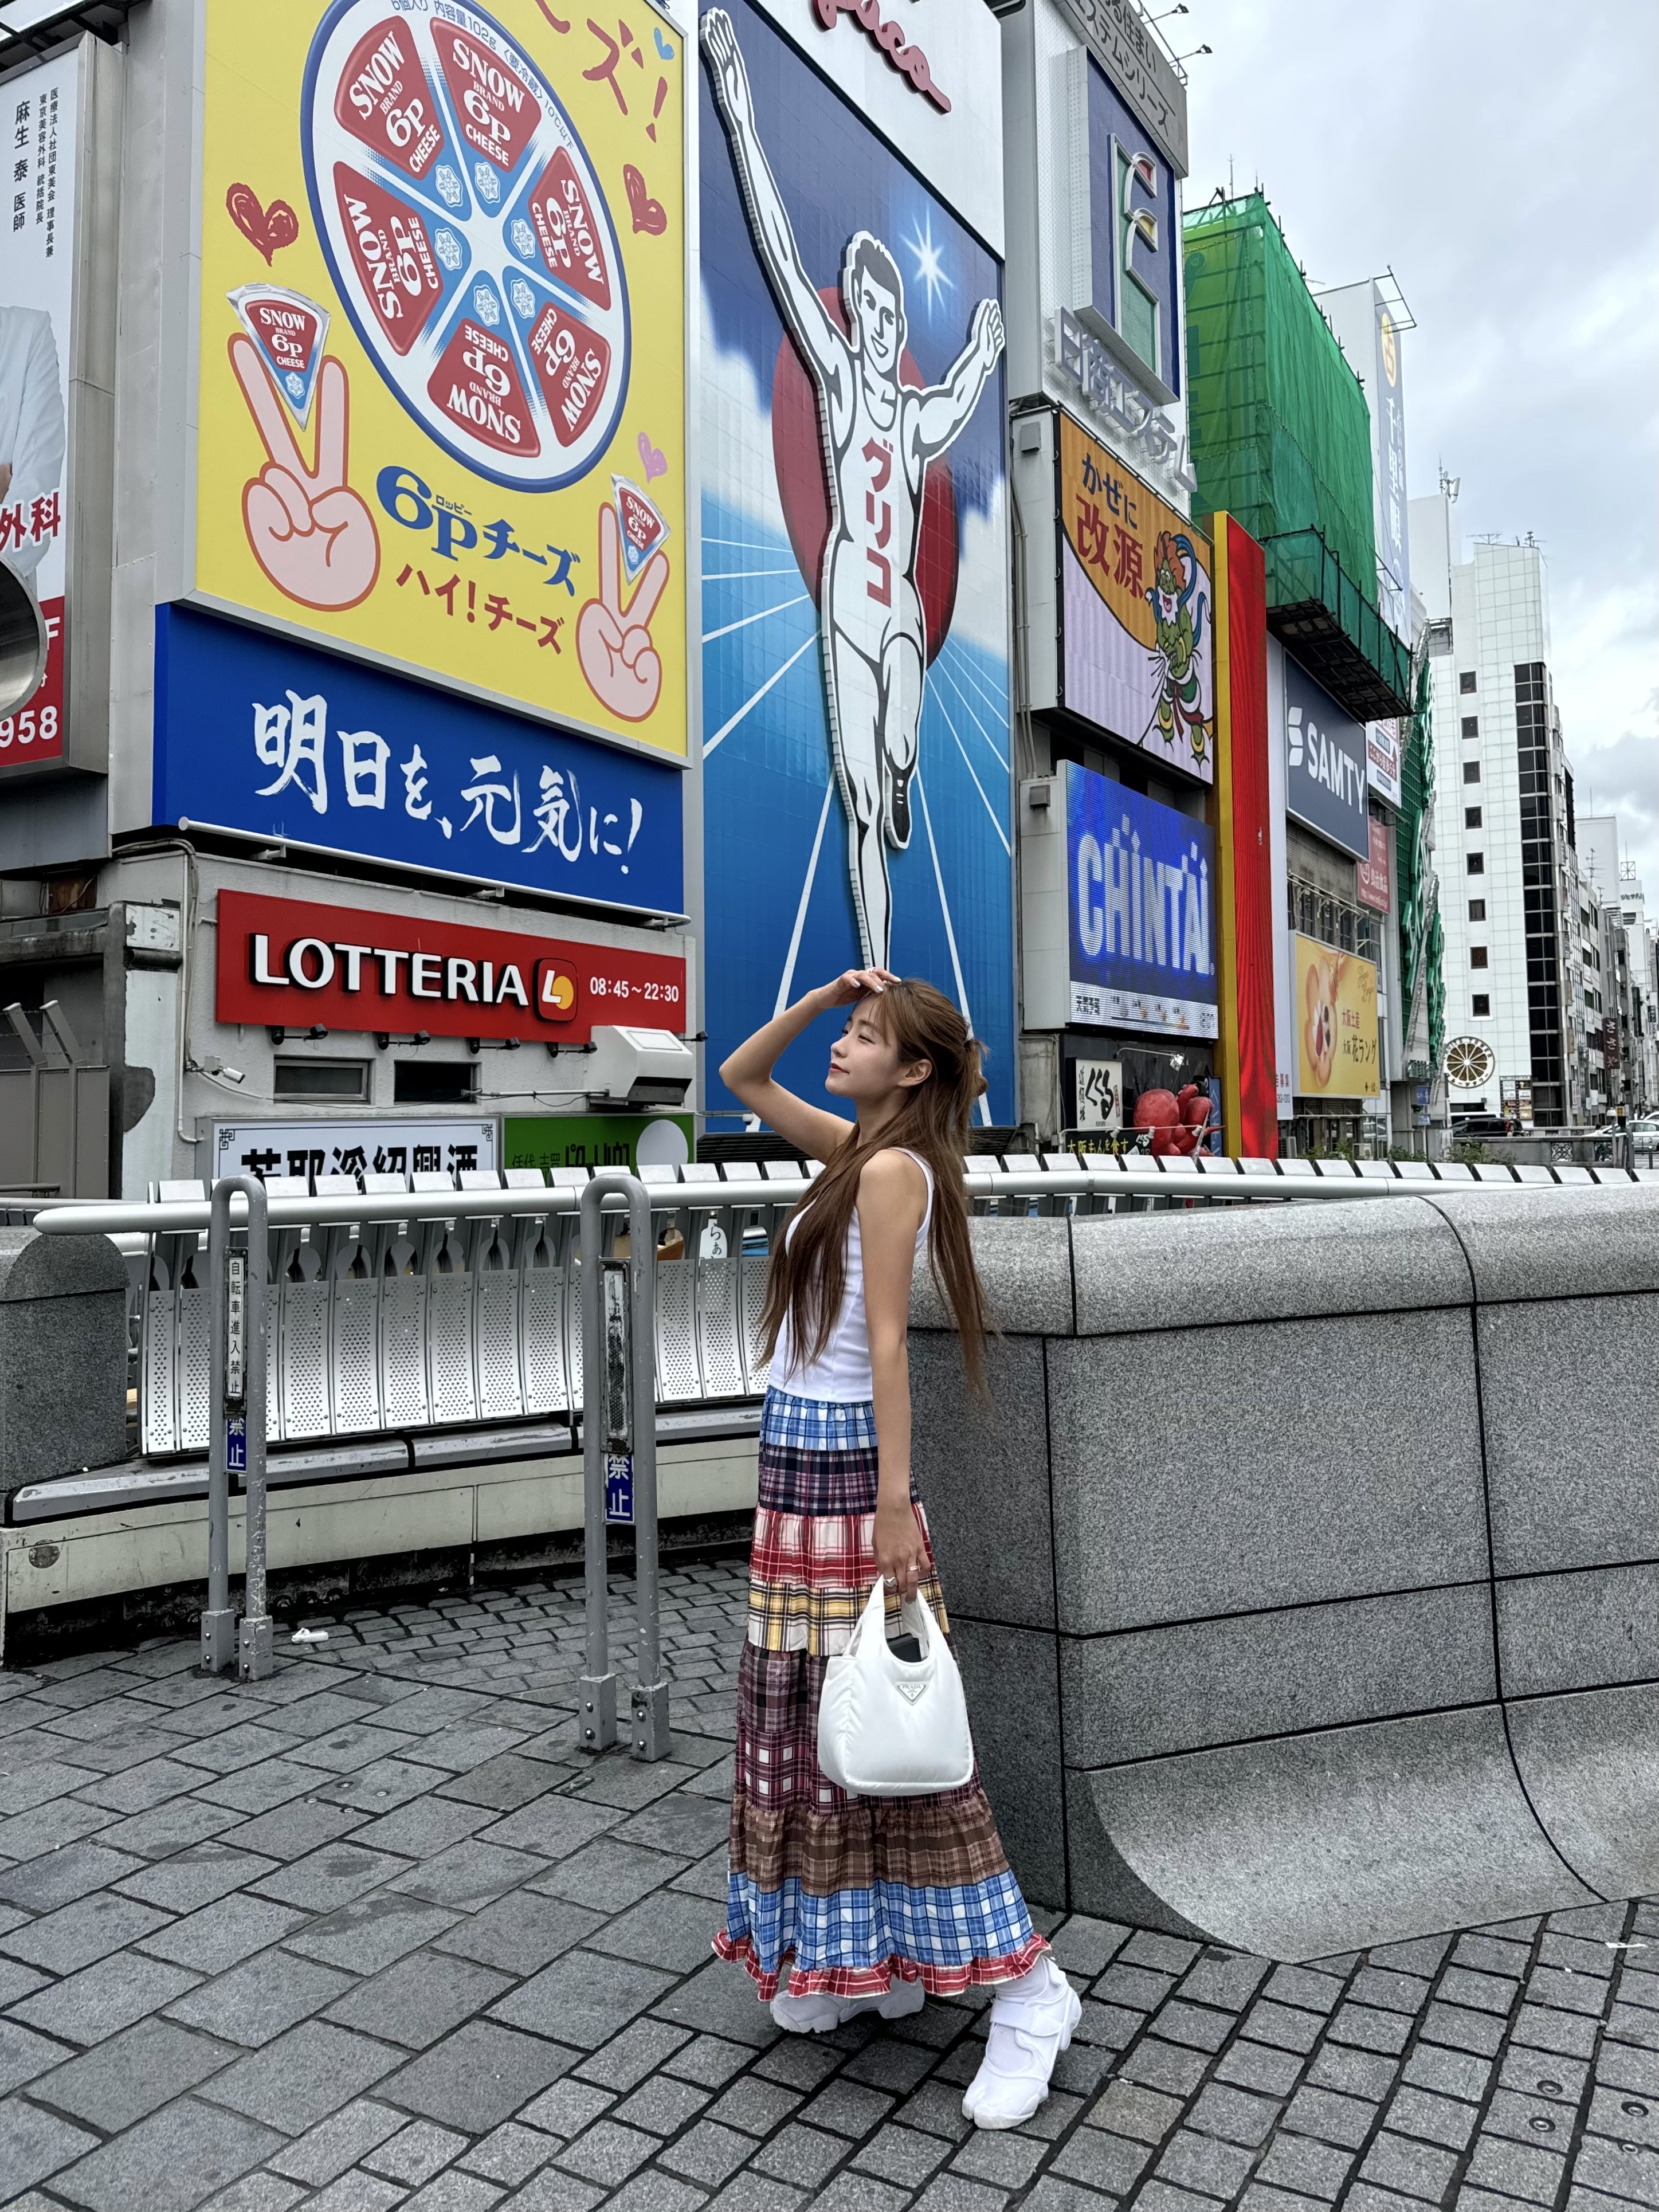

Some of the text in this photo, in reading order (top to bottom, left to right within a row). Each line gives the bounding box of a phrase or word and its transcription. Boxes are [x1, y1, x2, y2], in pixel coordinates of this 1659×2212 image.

[434, 1, 496, 50] 内容量102g
[1105, 0, 1156, 74] る住まい
[350, 31, 405, 120] SNOW
[379, 80, 403, 115] BRAND
[453, 38, 525, 113] SNOW
[473, 80, 505, 112] BRAND
[1070, 0, 1169, 138] ステムシリーズ
[13, 100, 30, 233] 麻生 泰 医師
[36, 93, 48, 226] 東京美容外科 統括院長
[45, 87, 58, 258] 医療法人社団東美会 理事長兼
[409, 124, 441, 172] CHEESE
[465, 123, 509, 166] CHEESE
[344, 194, 403, 319] SNOW
[378, 229, 401, 283] BRAND
[408, 217, 438, 289] CHEESE
[532, 202, 558, 268] CHEESE
[560, 179, 604, 284] SNOW
[563, 210, 581, 256] BRAND
[260, 307, 305, 331] SNOW
[275, 327, 296, 336] BRAND
[465, 324, 508, 362] CHEESE
[531, 308, 558, 355] CHEESE
[276, 356, 305, 368] CHEESE
[561, 348, 601, 432] SNOW
[562, 355, 580, 389] BRAND
[446, 384, 520, 444] SNOW
[469, 382, 501, 407] BRAND
[436, 495, 472, 515] ロッピー
[1083, 453, 1138, 530] かぜに
[1386, 396, 1402, 555] 千里眼
[0, 491, 61, 551] 外科
[626, 496, 655, 529] SNOW
[626, 530, 644, 550] CHEESE
[861, 437, 893, 609] グリコ
[1076, 493, 1144, 600] 改源
[396, 563, 565, 654] ハイ!チーズ
[0, 705, 57, 746] 958
[1307, 721, 1365, 814] SAMTY
[1078, 830, 1210, 975] CHINTAI
[253, 933, 528, 1006] LOTTERIA
[1085, 1068, 1114, 1120] くくる
[1068, 1138, 1129, 1156] 大阪もんを食す
[710, 1223, 722, 1258] らぁ
[230, 1261, 241, 1395] 自転車進入禁止
[608, 1453, 630, 1517] 禁止
